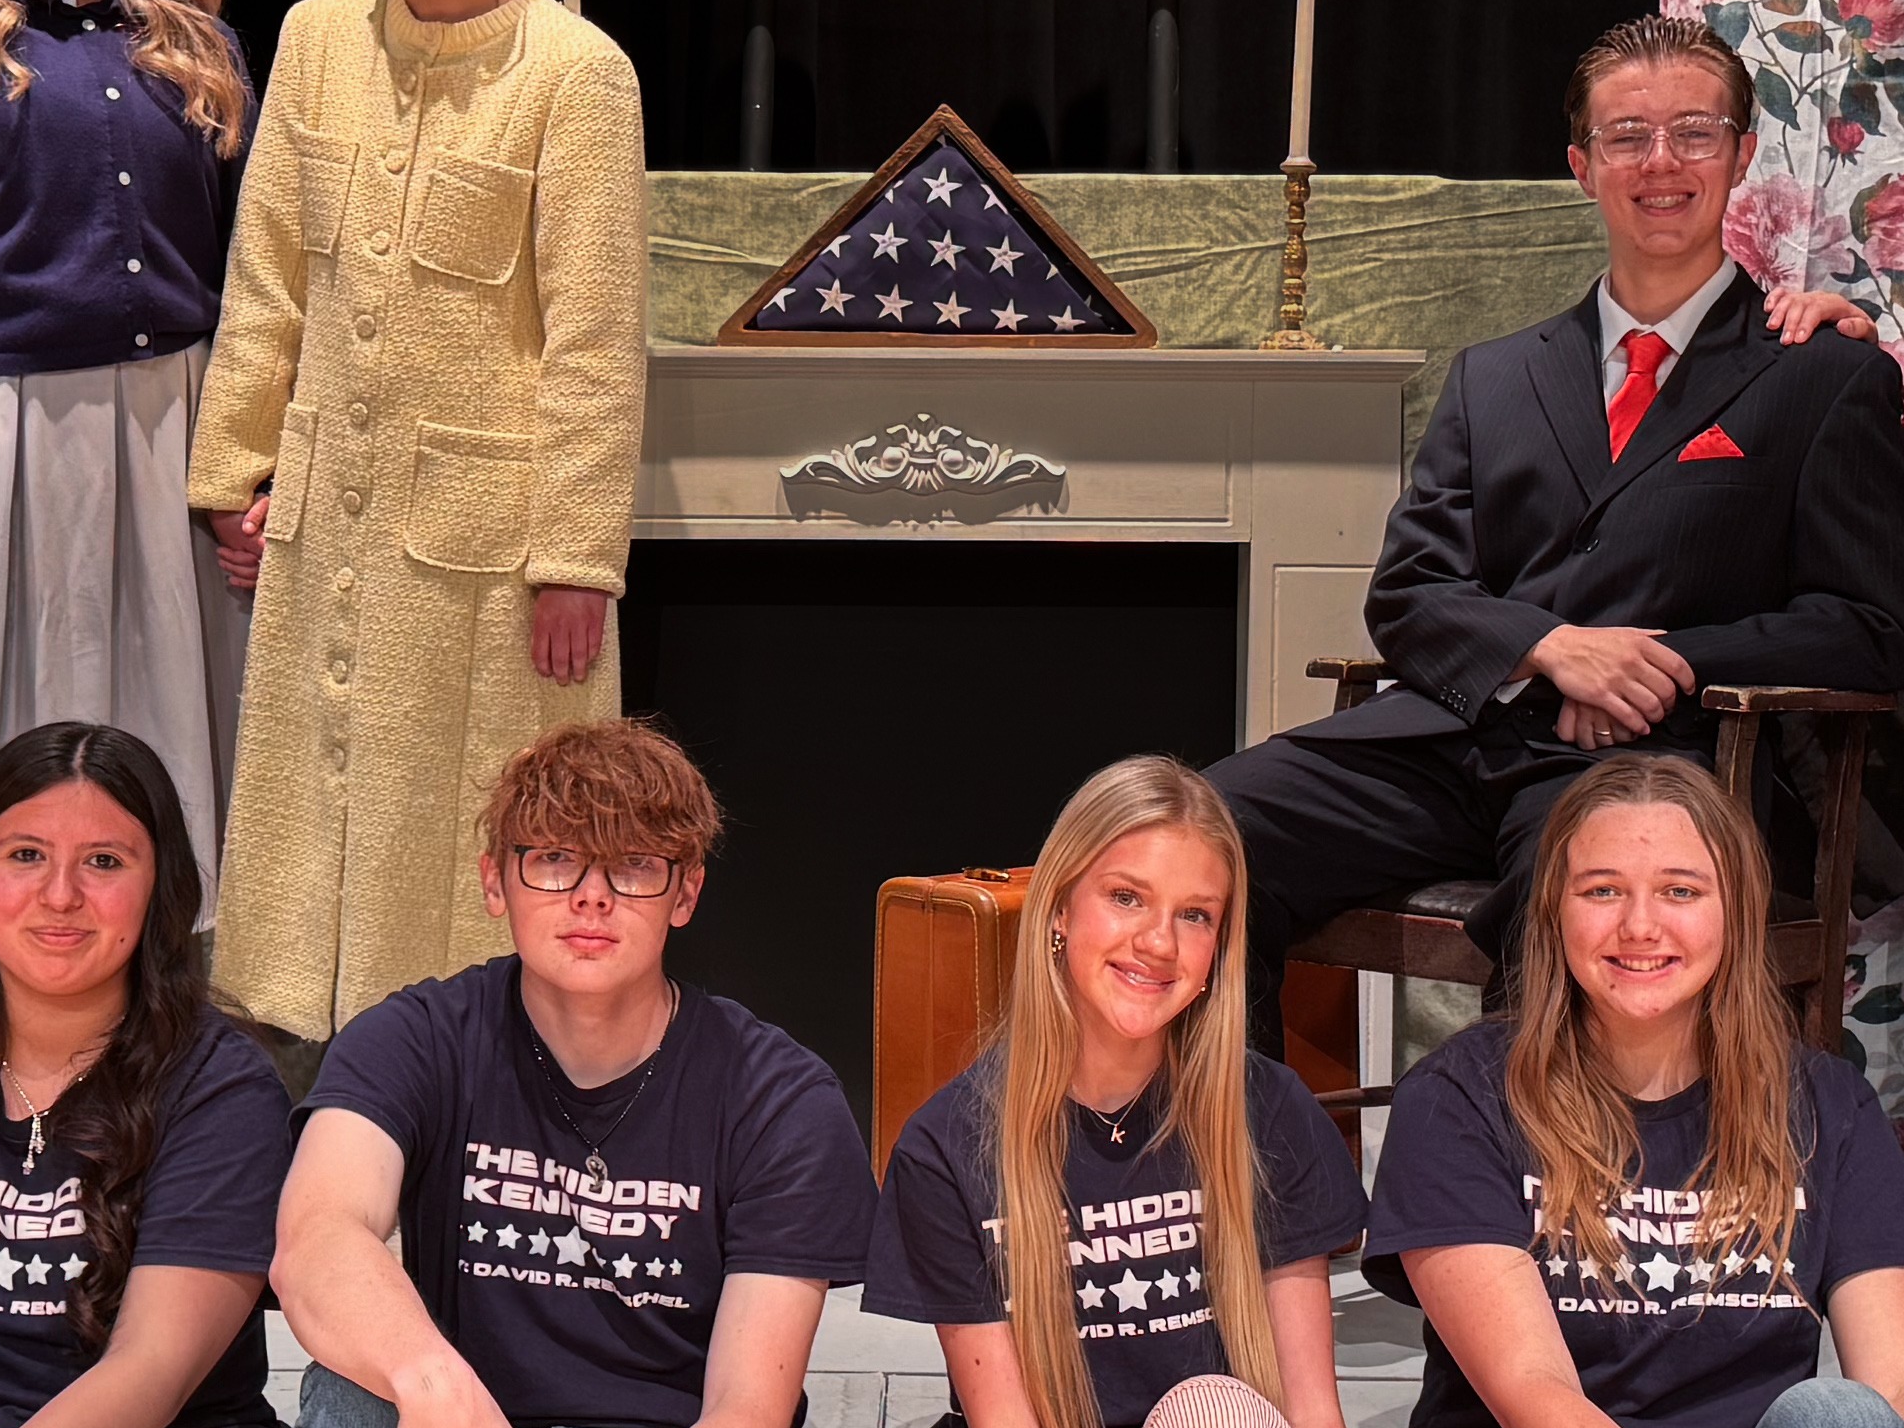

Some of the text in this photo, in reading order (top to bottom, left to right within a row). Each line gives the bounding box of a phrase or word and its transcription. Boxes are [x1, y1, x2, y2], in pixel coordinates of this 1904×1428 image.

[544, 1158, 701, 1211] HIDDEN
[1081, 1189, 1204, 1232] HIDD
[1066, 1222, 1203, 1266] NNED
[473, 1262, 551, 1285] DAVID
[555, 1273, 579, 1288] R.
[583, 1276, 690, 1309] RECHEL
[1558, 1296, 1639, 1315] DAVID
[1644, 1300, 1668, 1315] R.
[1119, 1322, 1145, 1338] R.
[1149, 1307, 1215, 1334] REMSC
